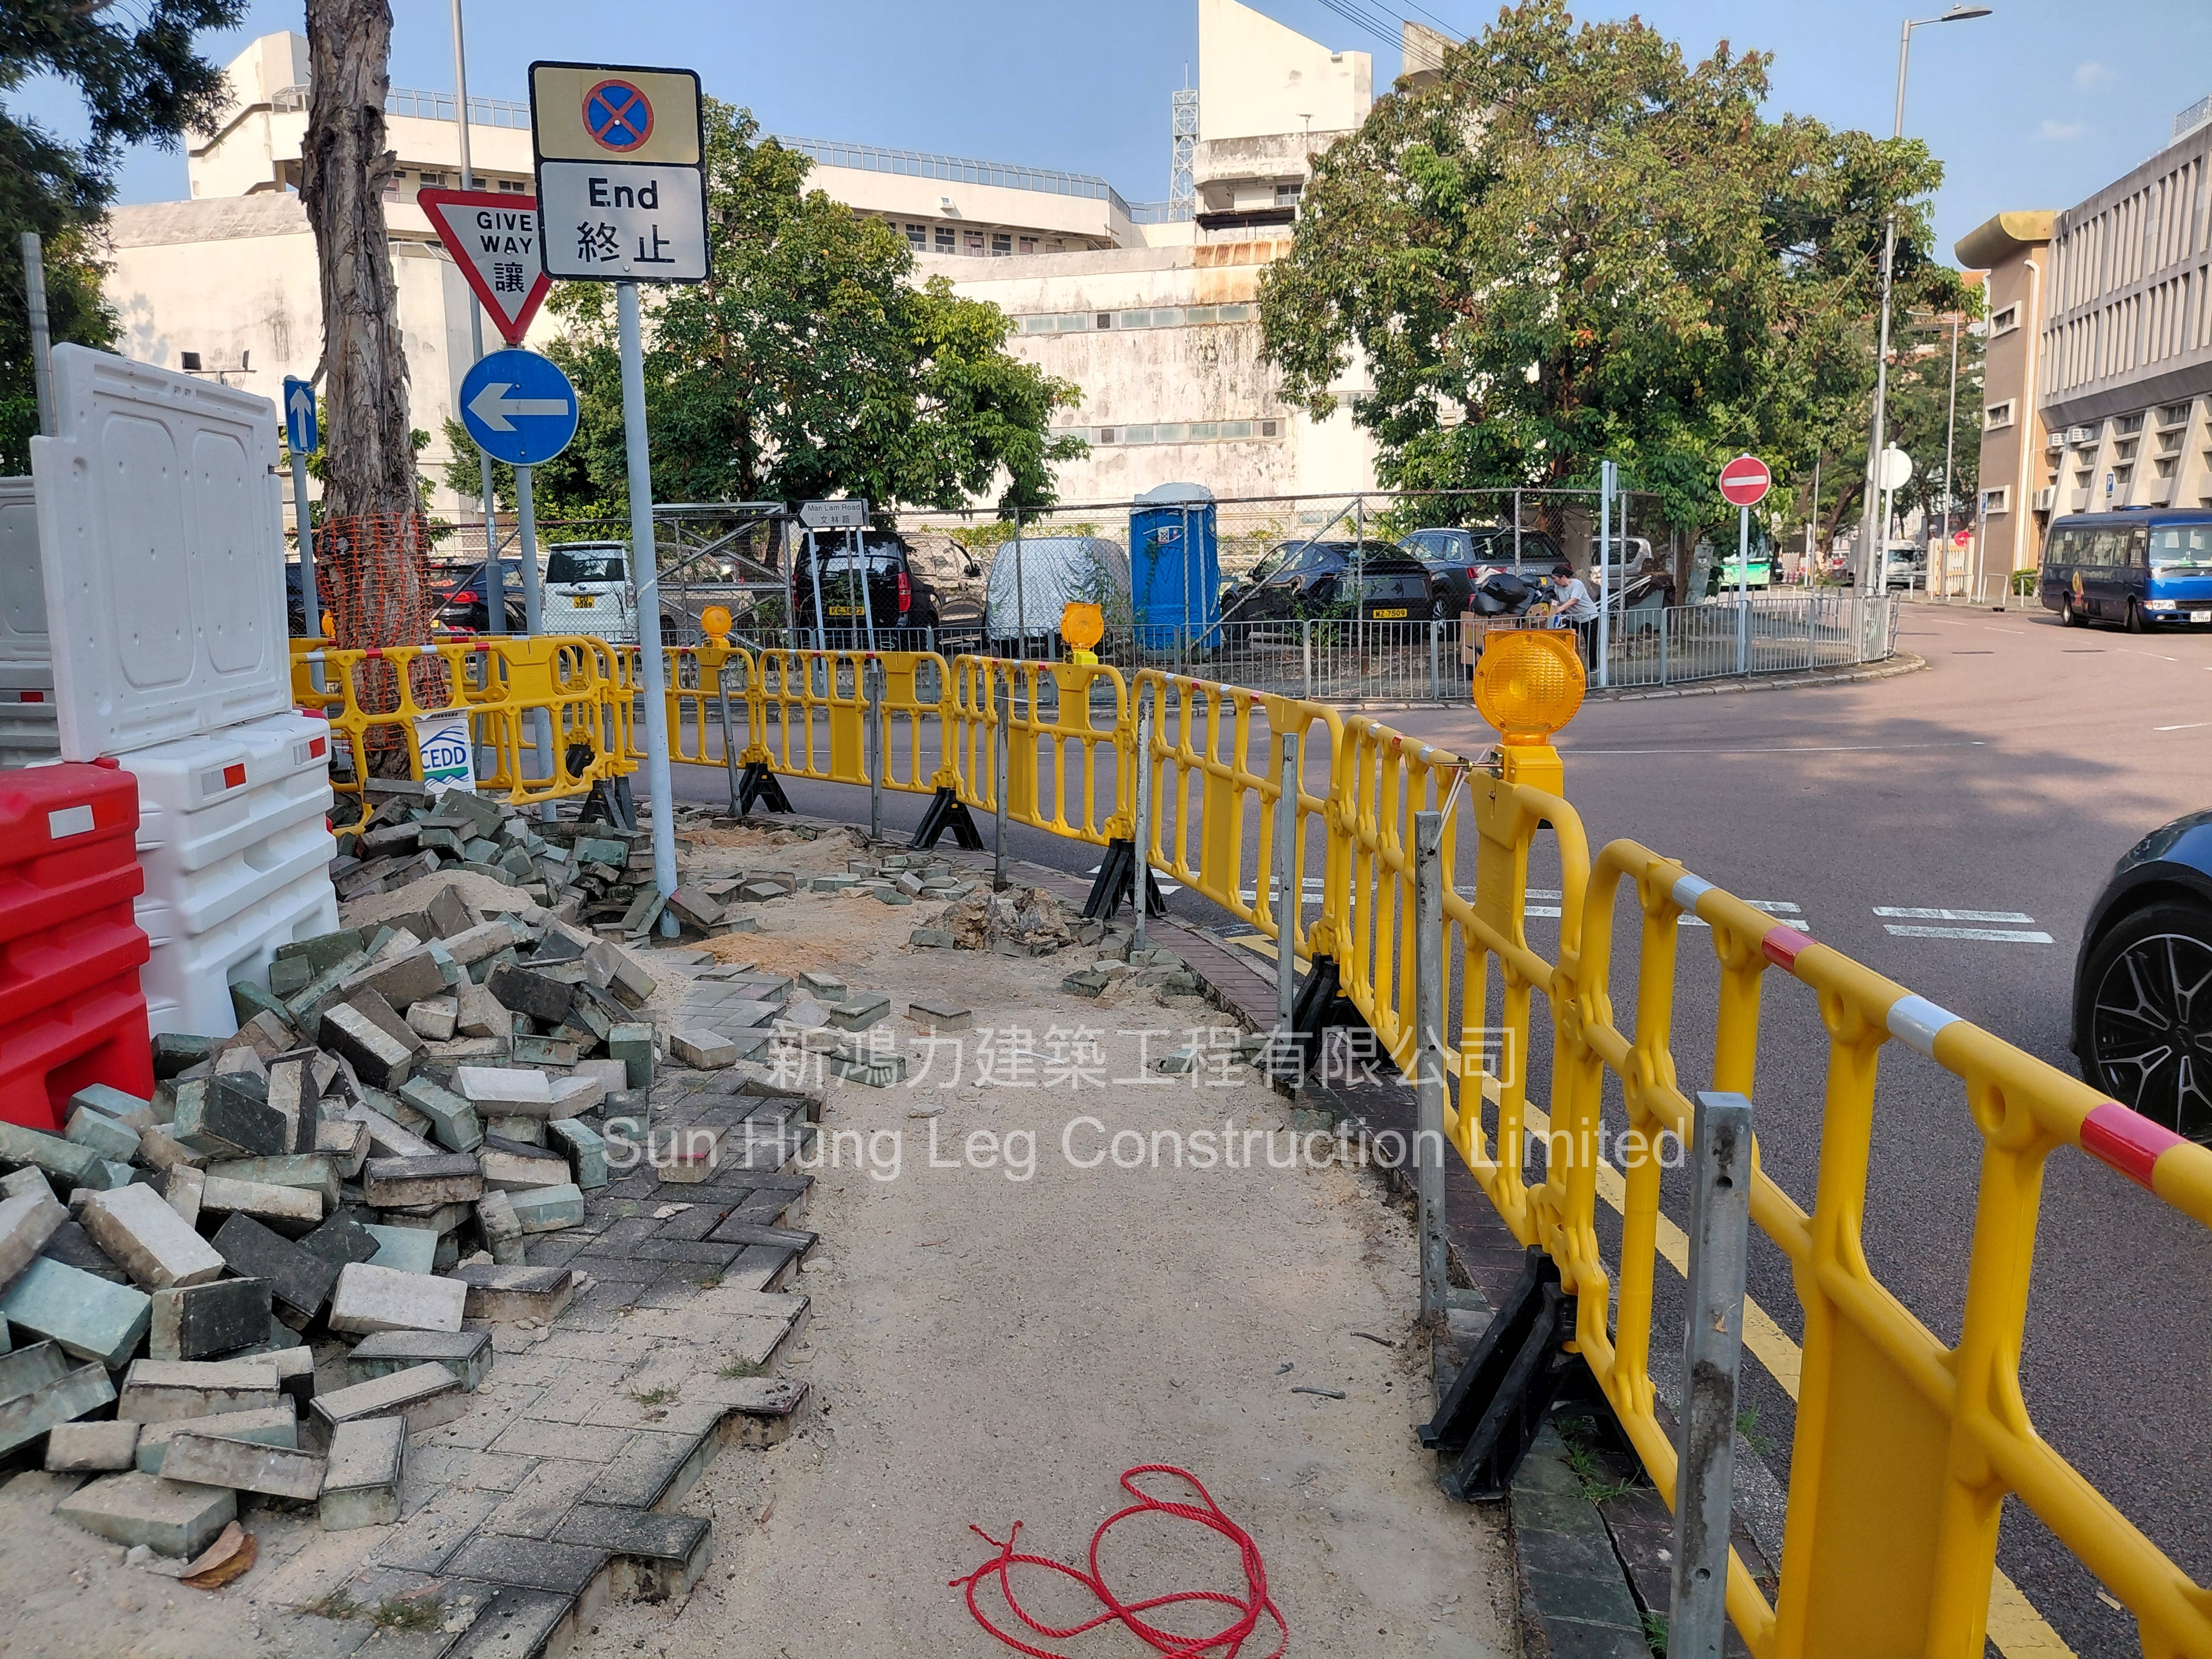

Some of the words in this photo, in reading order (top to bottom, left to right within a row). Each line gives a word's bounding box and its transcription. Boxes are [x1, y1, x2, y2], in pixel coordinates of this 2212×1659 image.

[589, 178, 659, 209] End
[477, 211, 532, 232] GIVE
[480, 235, 532, 254] WAY
[577, 221, 675, 263] 終止
[493, 262, 525, 293] 讓
[820, 515, 850, 524] 文林路
[421, 747, 466, 769] CEDD
